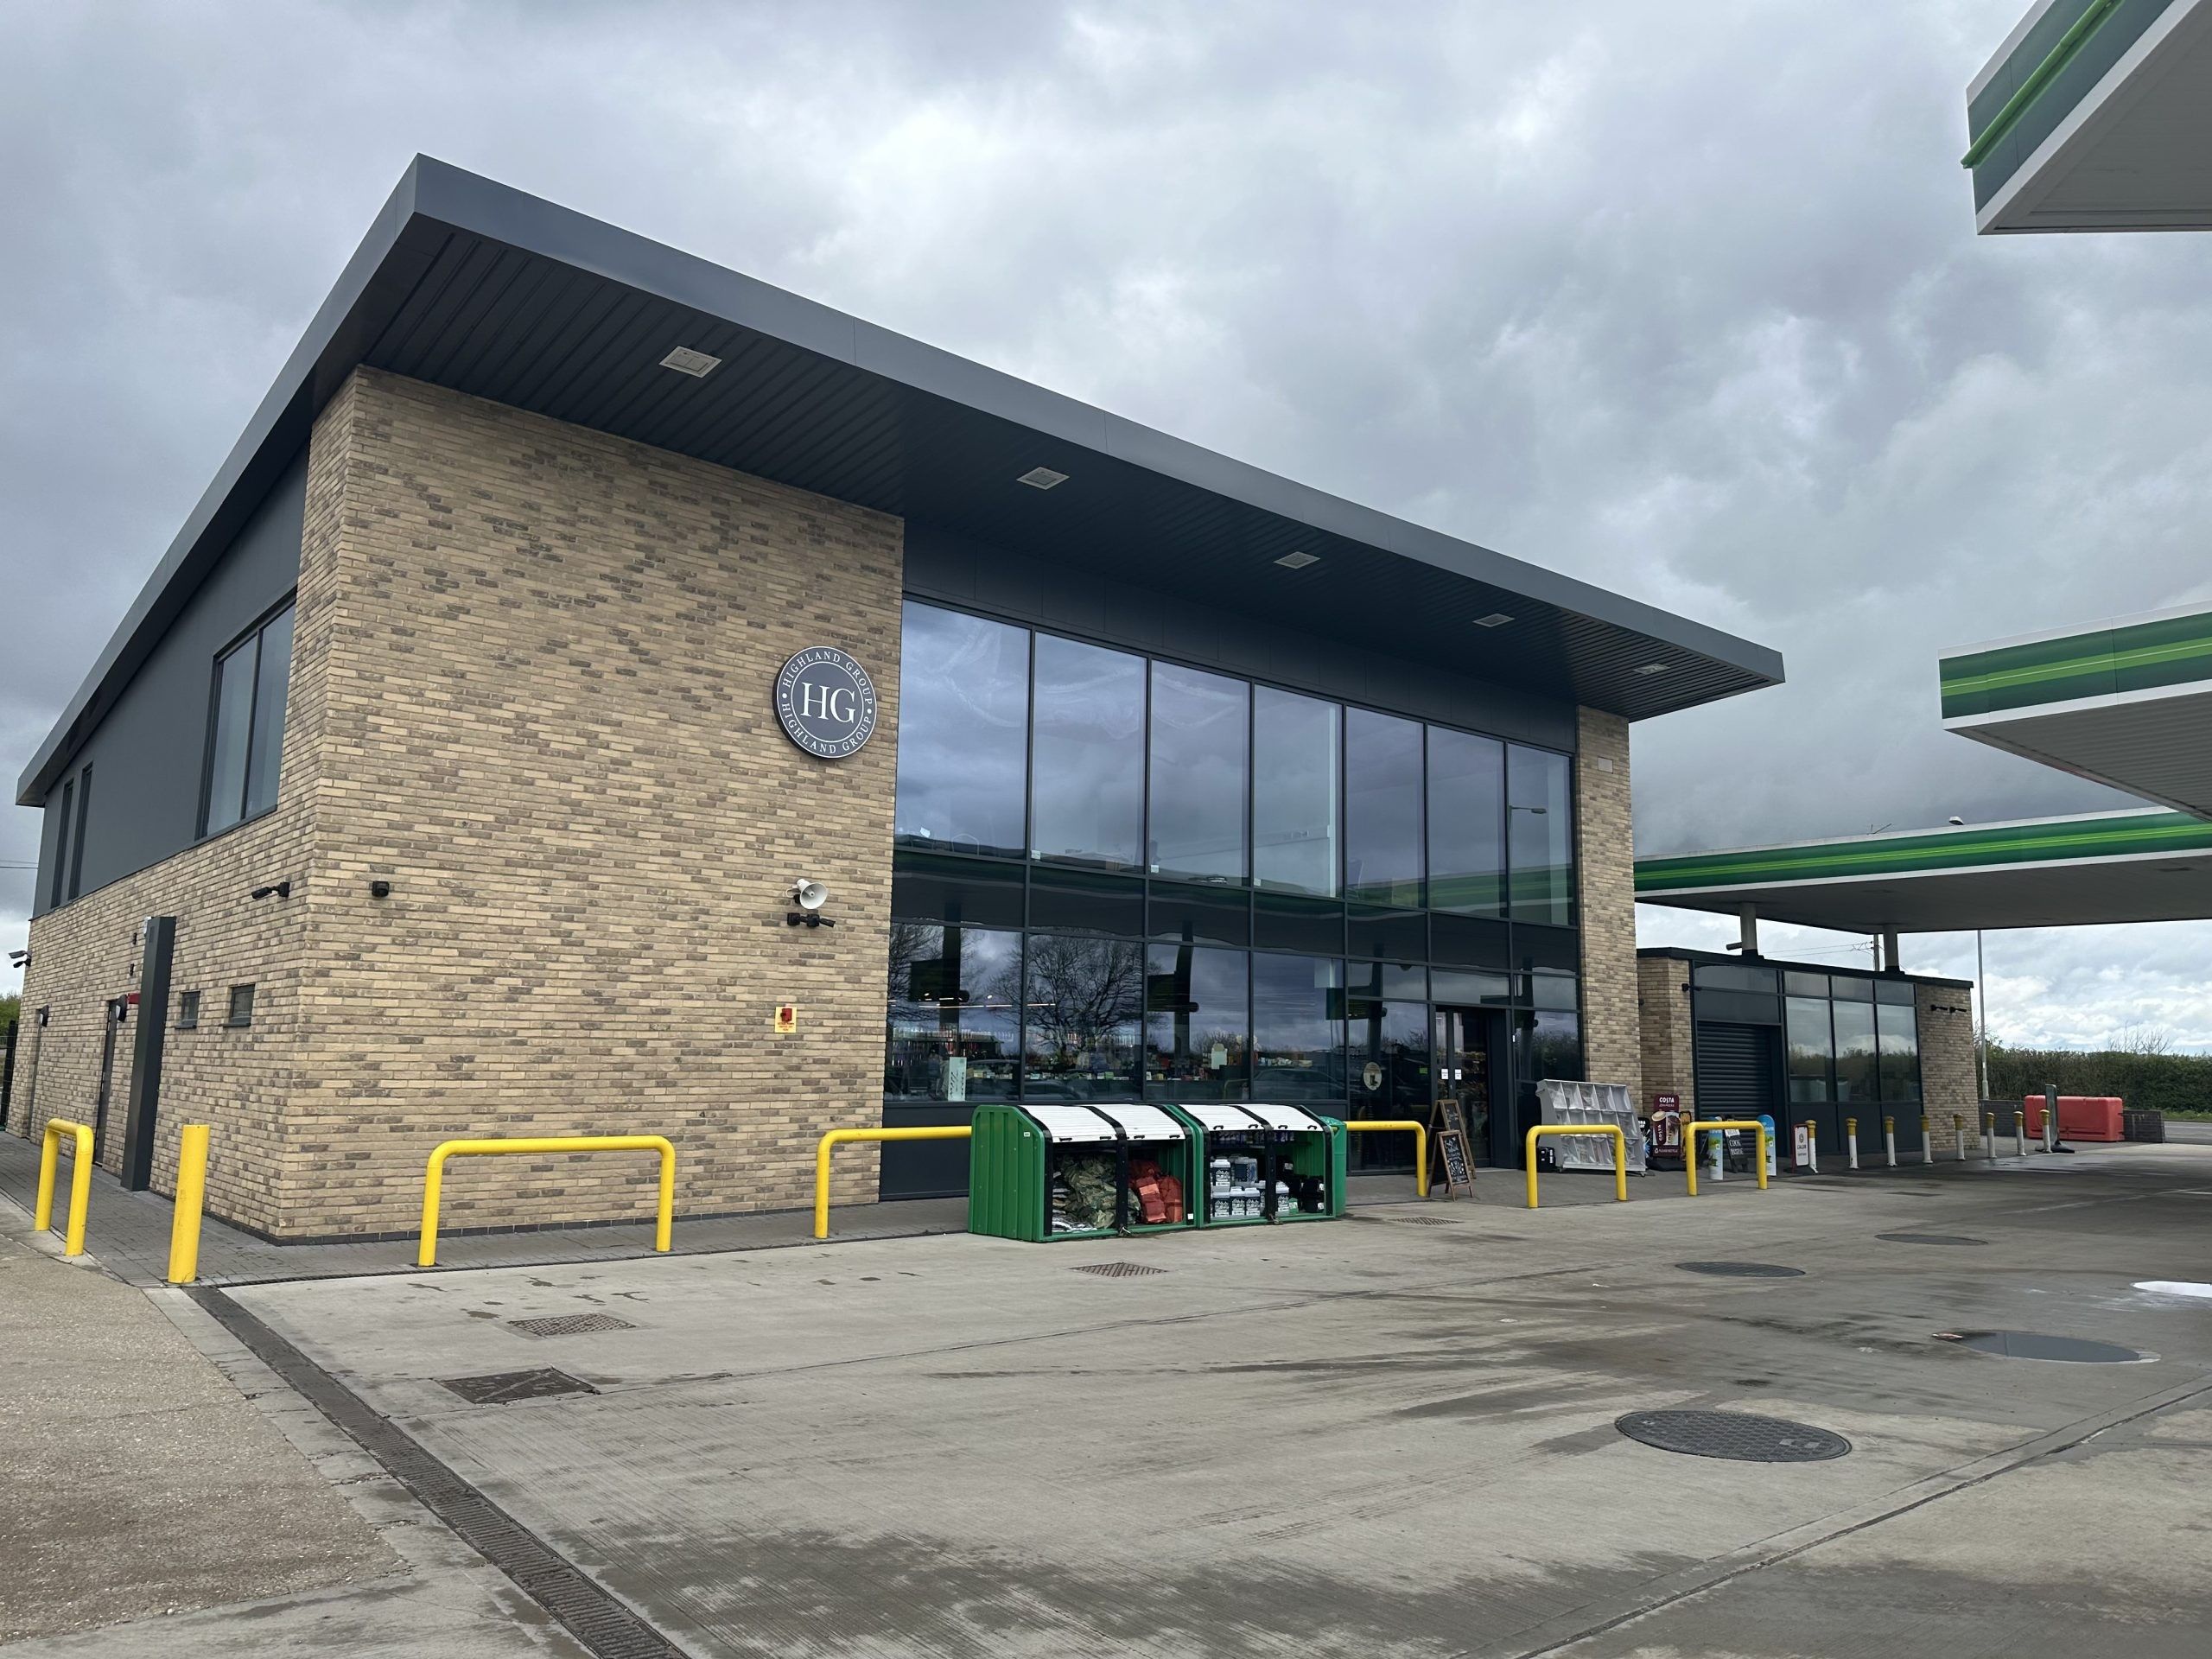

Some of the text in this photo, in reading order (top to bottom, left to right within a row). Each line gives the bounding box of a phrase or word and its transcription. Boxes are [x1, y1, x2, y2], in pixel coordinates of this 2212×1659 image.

[782, 651, 873, 705] HIGHLAND GROUP
[800, 682, 856, 724] HG
[781, 702, 872, 753] HIGHLAND GROUP
